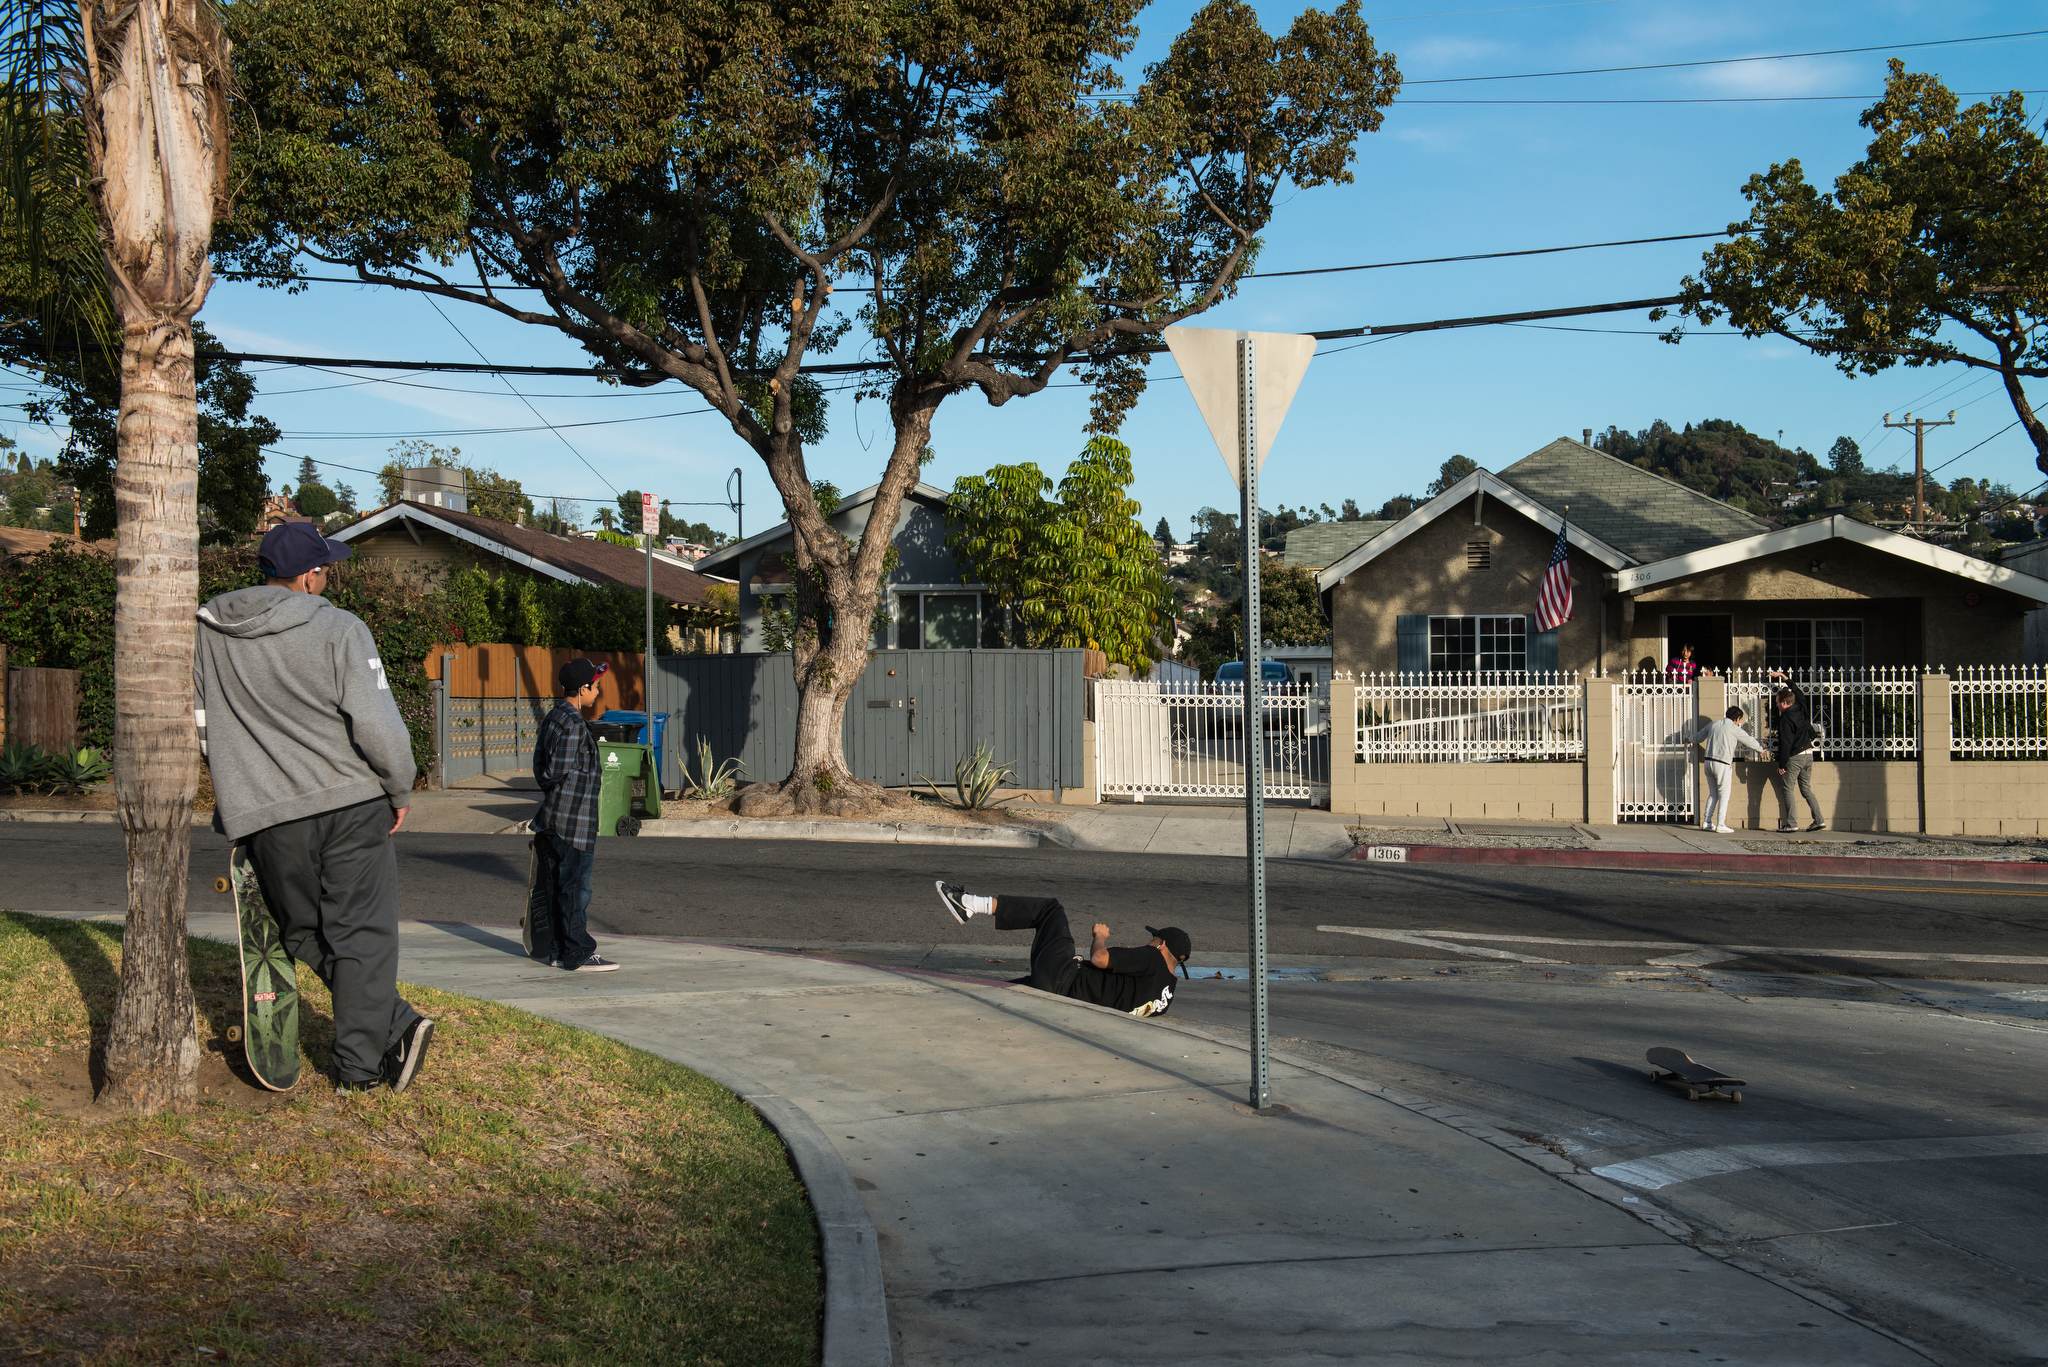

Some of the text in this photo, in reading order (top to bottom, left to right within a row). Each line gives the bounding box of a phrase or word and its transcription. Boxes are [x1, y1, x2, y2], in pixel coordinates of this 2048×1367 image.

[644, 506, 658, 515] PARKING
[1631, 572, 1651, 581] 1306
[1374, 848, 1401, 860] 1306
[263, 992, 276, 1000] TIMES
